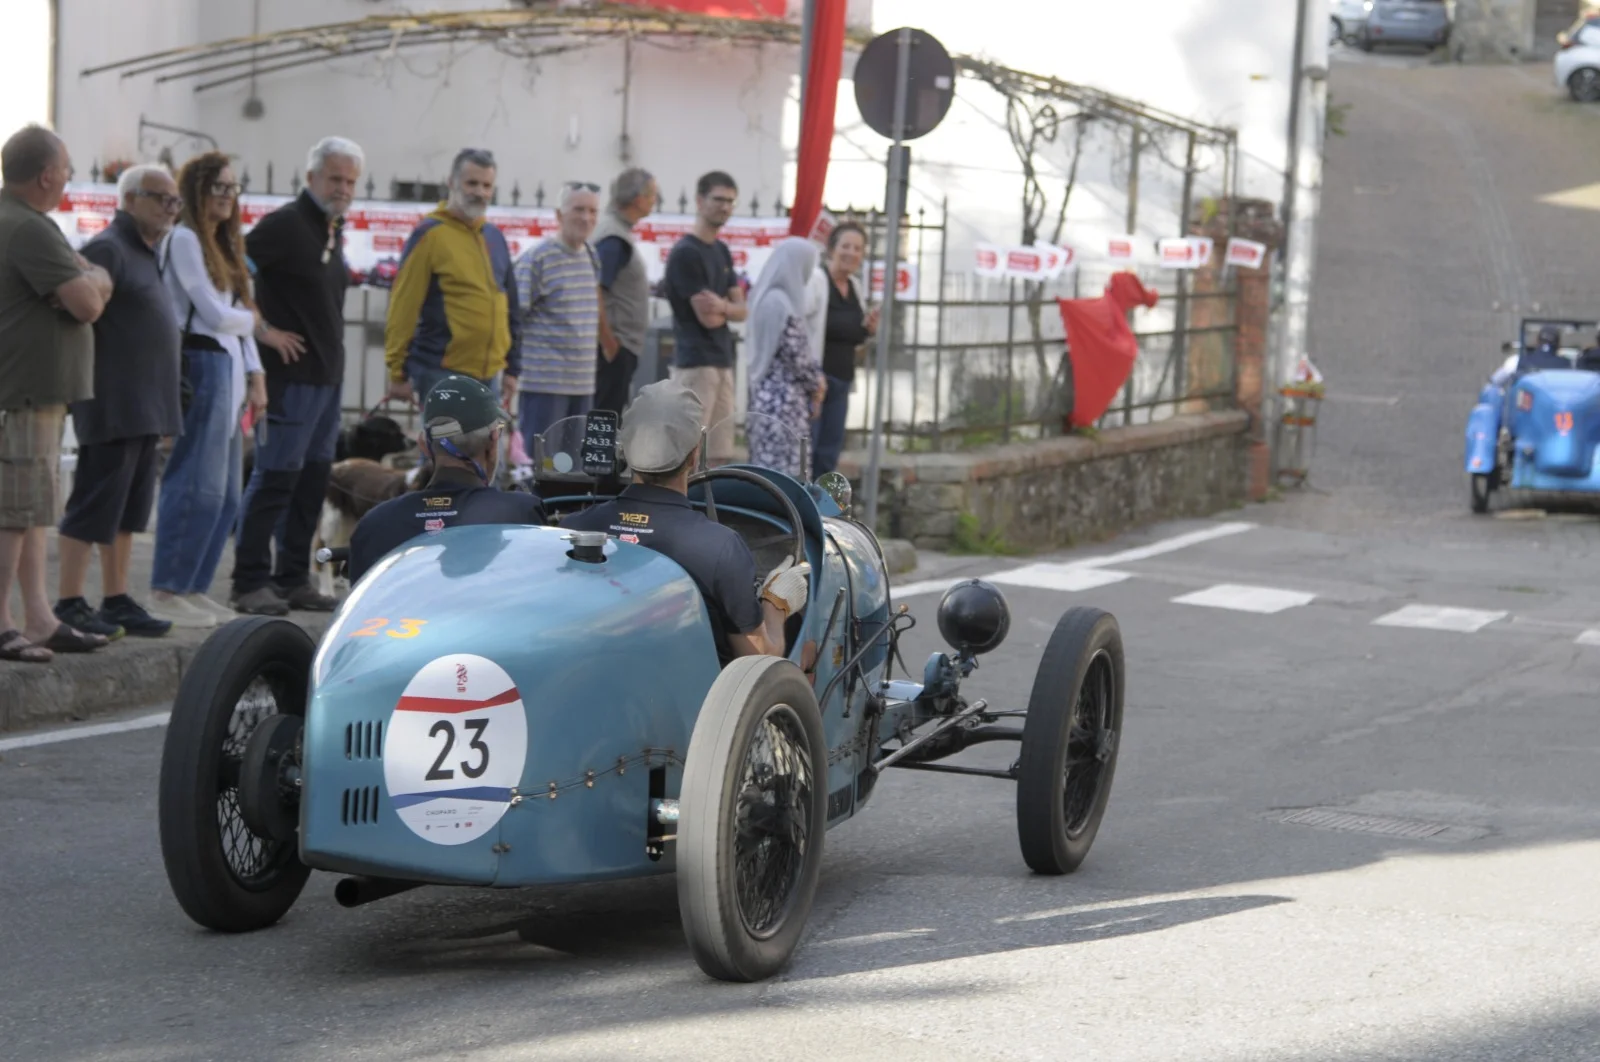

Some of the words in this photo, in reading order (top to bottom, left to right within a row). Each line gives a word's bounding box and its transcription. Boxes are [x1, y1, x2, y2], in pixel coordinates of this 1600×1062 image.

[587, 423, 611, 432] 24.33
[586, 437, 610, 447] 24.33
[585, 452, 606, 463] 24.1
[348, 617, 428, 639] 23
[424, 718, 490, 781] 23
